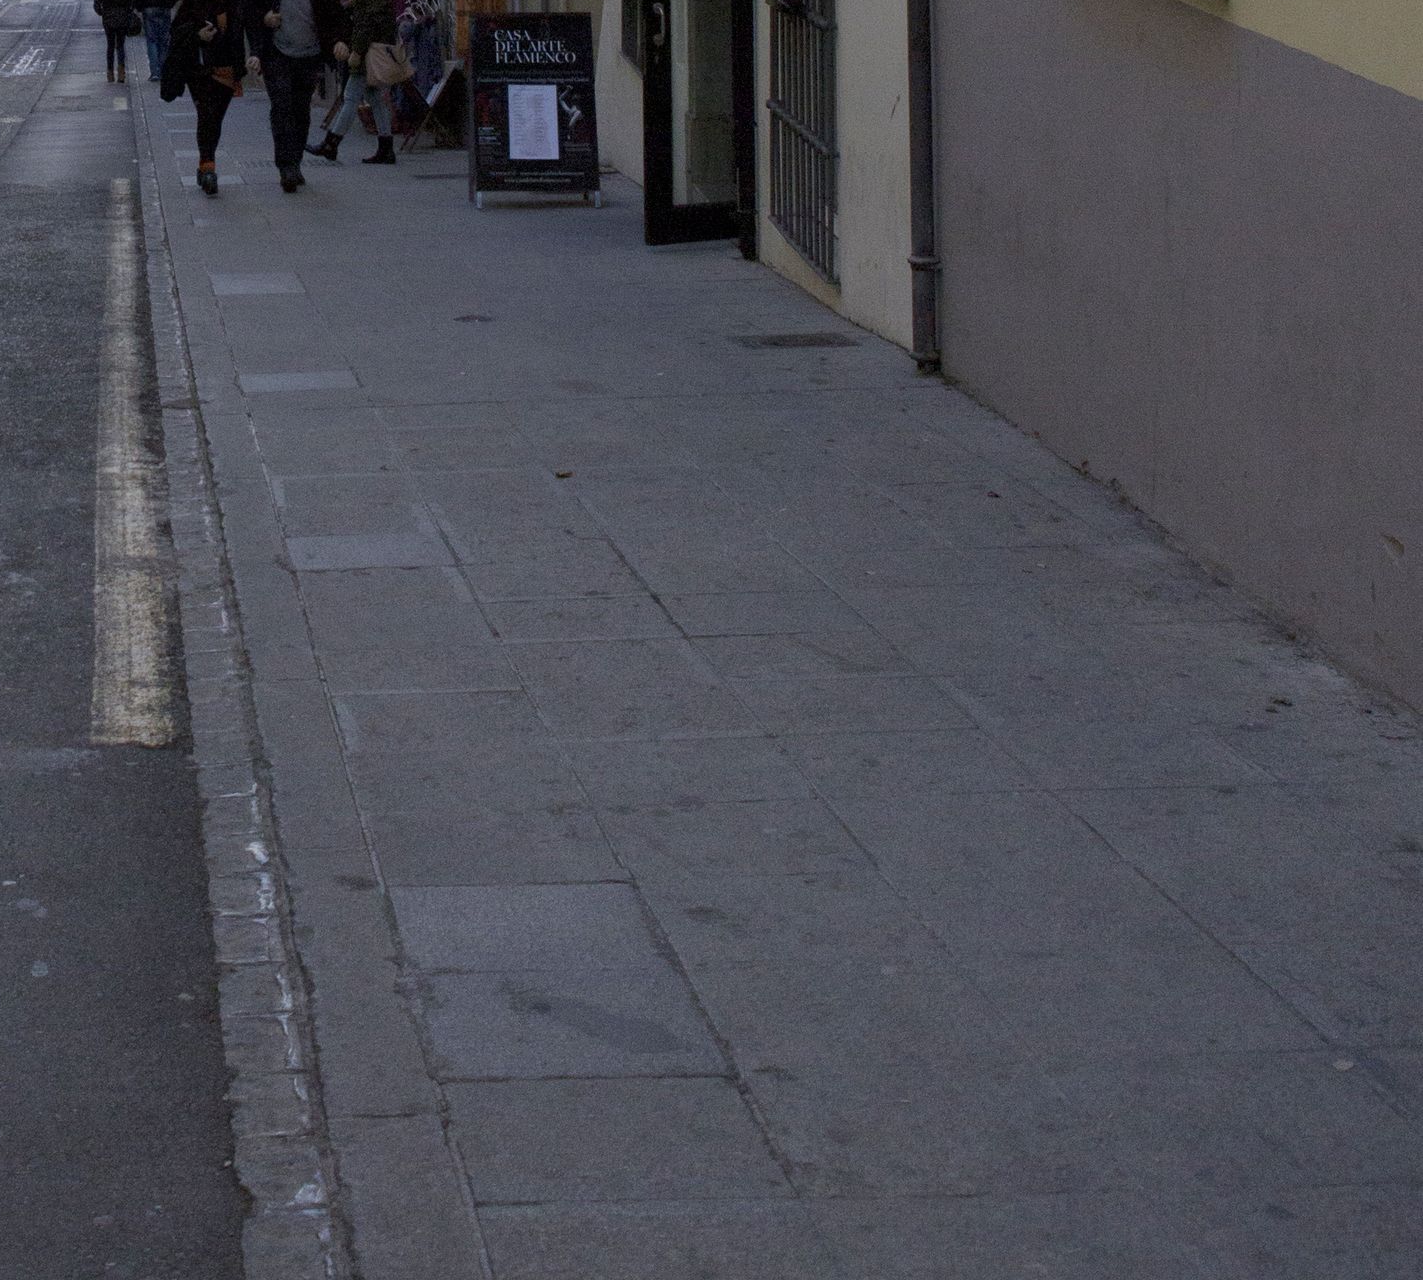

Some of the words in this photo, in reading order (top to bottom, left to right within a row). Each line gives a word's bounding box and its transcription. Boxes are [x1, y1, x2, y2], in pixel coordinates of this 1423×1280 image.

[494, 29, 531, 40] CASA
[495, 40, 526, 52] DEL
[527, 40, 566, 52] ARTE
[495, 52, 577, 64] FLAMENCO
